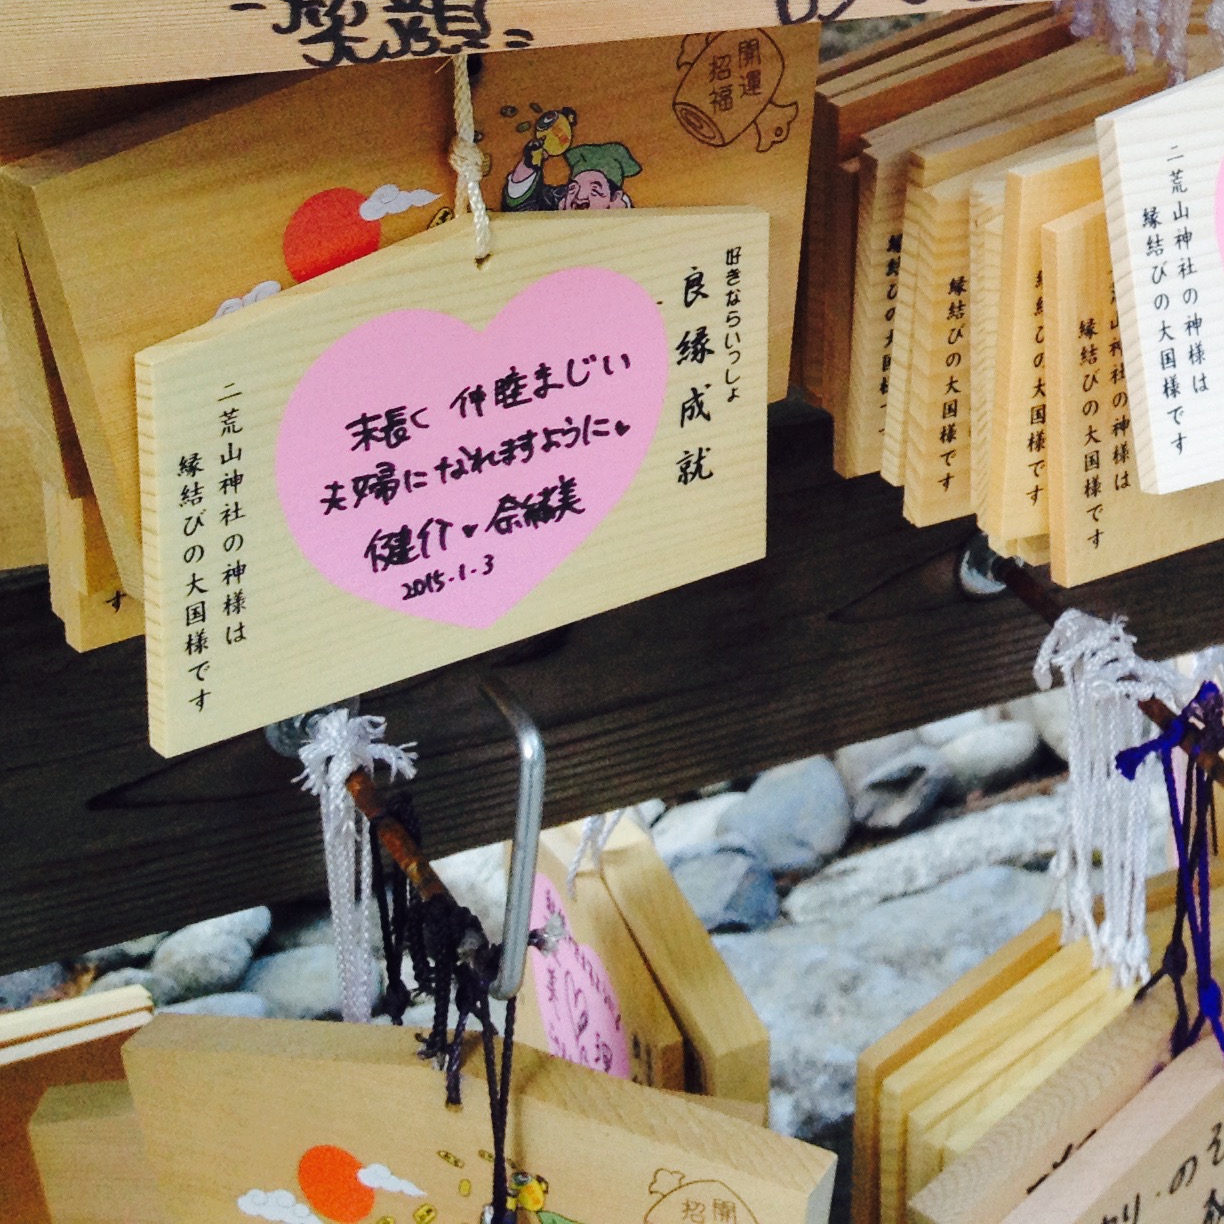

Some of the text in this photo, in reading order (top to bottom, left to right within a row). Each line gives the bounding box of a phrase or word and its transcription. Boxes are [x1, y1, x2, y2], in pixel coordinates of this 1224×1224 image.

[707, 53, 736, 115] 招福
[737, 38, 764, 98] 開運
[675, 266, 715, 487] 良縁成就
[723, 245, 743, 405] 好きならいっしょ
[1141, 207, 1188, 455] 縁結びの大国様です
[1164, 143, 1212, 394] 二荒山神社の神様は
[449, 352, 632, 420] 仲睦まじい
[935, 275, 968, 493] 縁結びの大国様です
[1077, 317, 1106, 551] 縁結びの大国様です
[178, 454, 213, 713] 縁結びの大国様です
[216, 382, 248, 645] 二荒山神社の神様は
